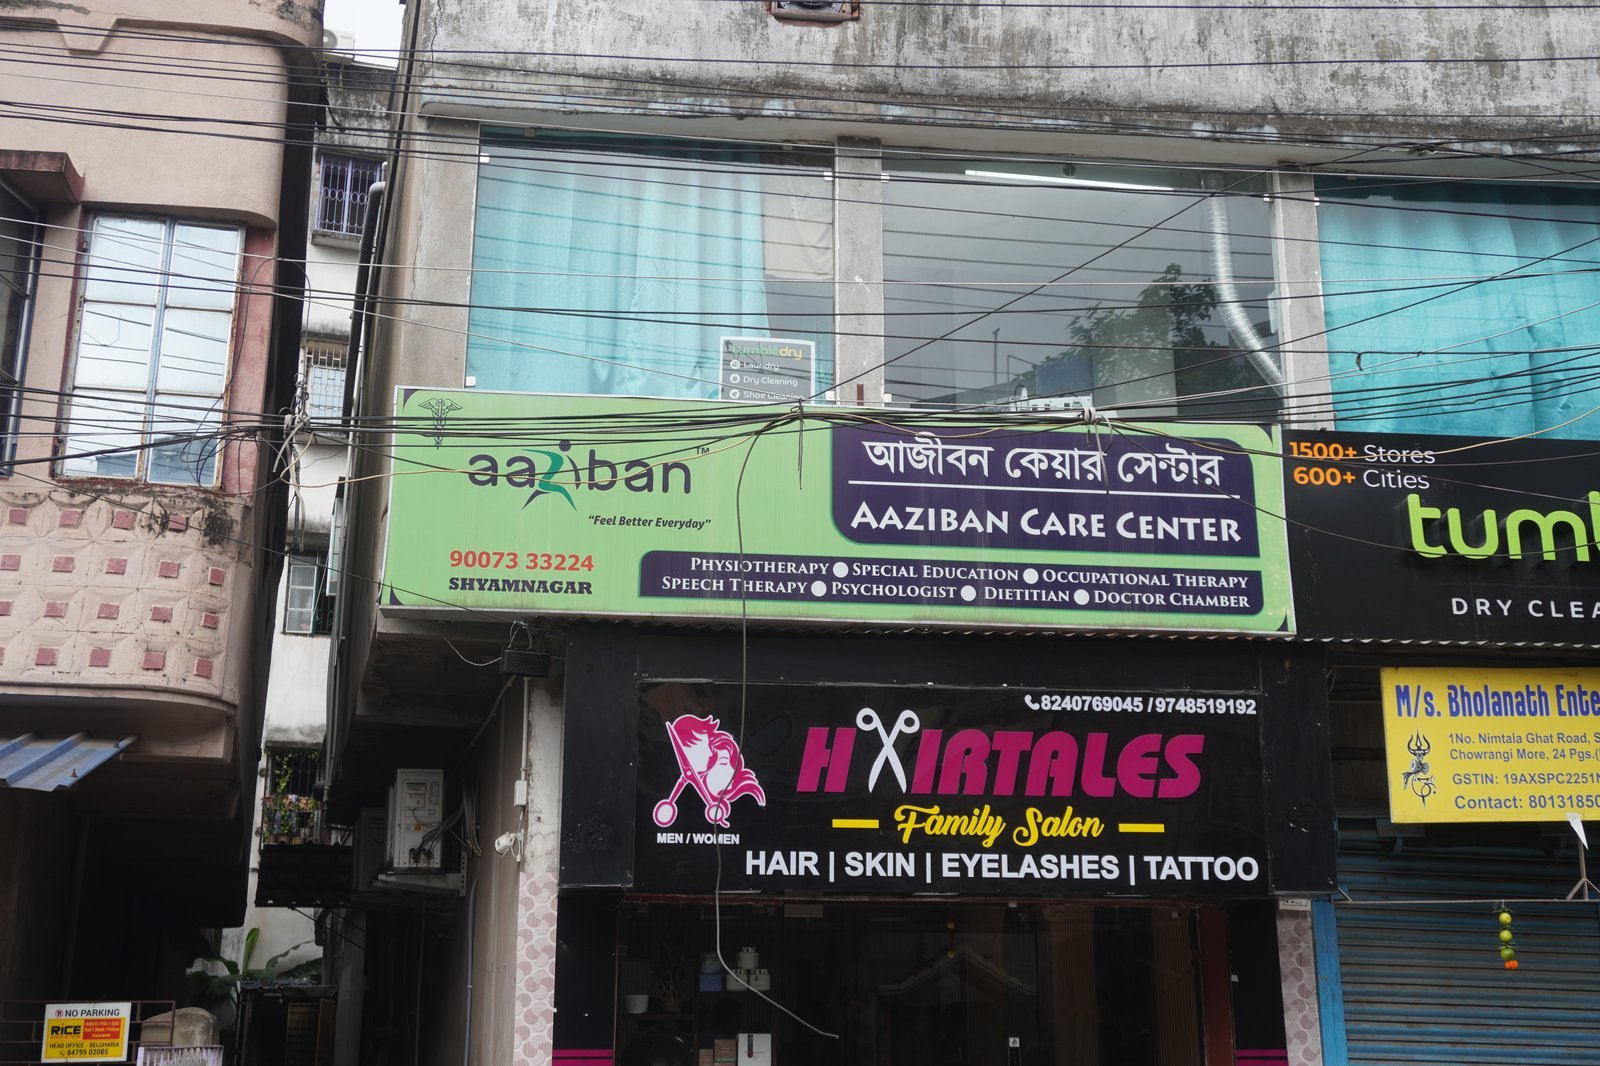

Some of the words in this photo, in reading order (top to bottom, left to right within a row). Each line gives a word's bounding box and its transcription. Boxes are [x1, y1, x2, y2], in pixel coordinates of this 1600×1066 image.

[743, 361, 780, 371] Laundry
[743, 376, 760, 386] Dry
[761, 377, 798, 387] Cleaning
[743, 391, 766, 399] Shoe
[861, 431, 995, 478] আজীবন
[1005, 447, 1107, 482] কেয়ার
[1117, 443, 1225, 486] সেন্টার
[1289, 441, 1357, 460] 1500+
[1363, 444, 1436, 464] Stores
[1293, 467, 1355, 486] 600+
[1363, 469, 1430, 489] Cities
[619, 515, 653, 528] Better
[1020, 508, 1106, 538] CARE
[1116, 511, 1241, 543] CENTER
[1408, 491, 1600, 562] tum
[449, 550, 518, 569] 90073
[525, 552, 594, 572] 33224
[448, 577, 592, 596] SHYAMNAGAR
[1452, 598, 1512, 616] DRY
[1041, 695, 1144, 713] 8240769045
[1395, 685, 1441, 718] M/s.
[1447, 684, 1550, 717] Bholanath
[1449, 733, 1475, 744] 1No.
[1479, 733, 1523, 744] Nimtala
[1526, 733, 1554, 744] Ghat
[1557, 732, 1591, 745] Road,
[1450, 749, 1513, 762] Chowrangi
[1517, 749, 1550, 761] More,
[1553, 749, 1566, 759] 24
[1570, 748, 1600, 762] Pgs.(
[1452, 773, 1499, 785] GSTIN:
[1455, 795, 1523, 809] Contact:
[894, 804, 1006, 848] Family
[1013, 806, 1104, 847] Salon
[656, 833, 684, 844] MEN
[693, 833, 740, 845] WOMEN
[746, 851, 820, 876] HAIR
[844, 852, 915, 877] SKIN
[942, 853, 1119, 879] EYELASHES
[1144, 856, 1259, 881] TATTOO
[64, 1009, 78, 1017] NO
[80, 1009, 120, 1017] PARKING
